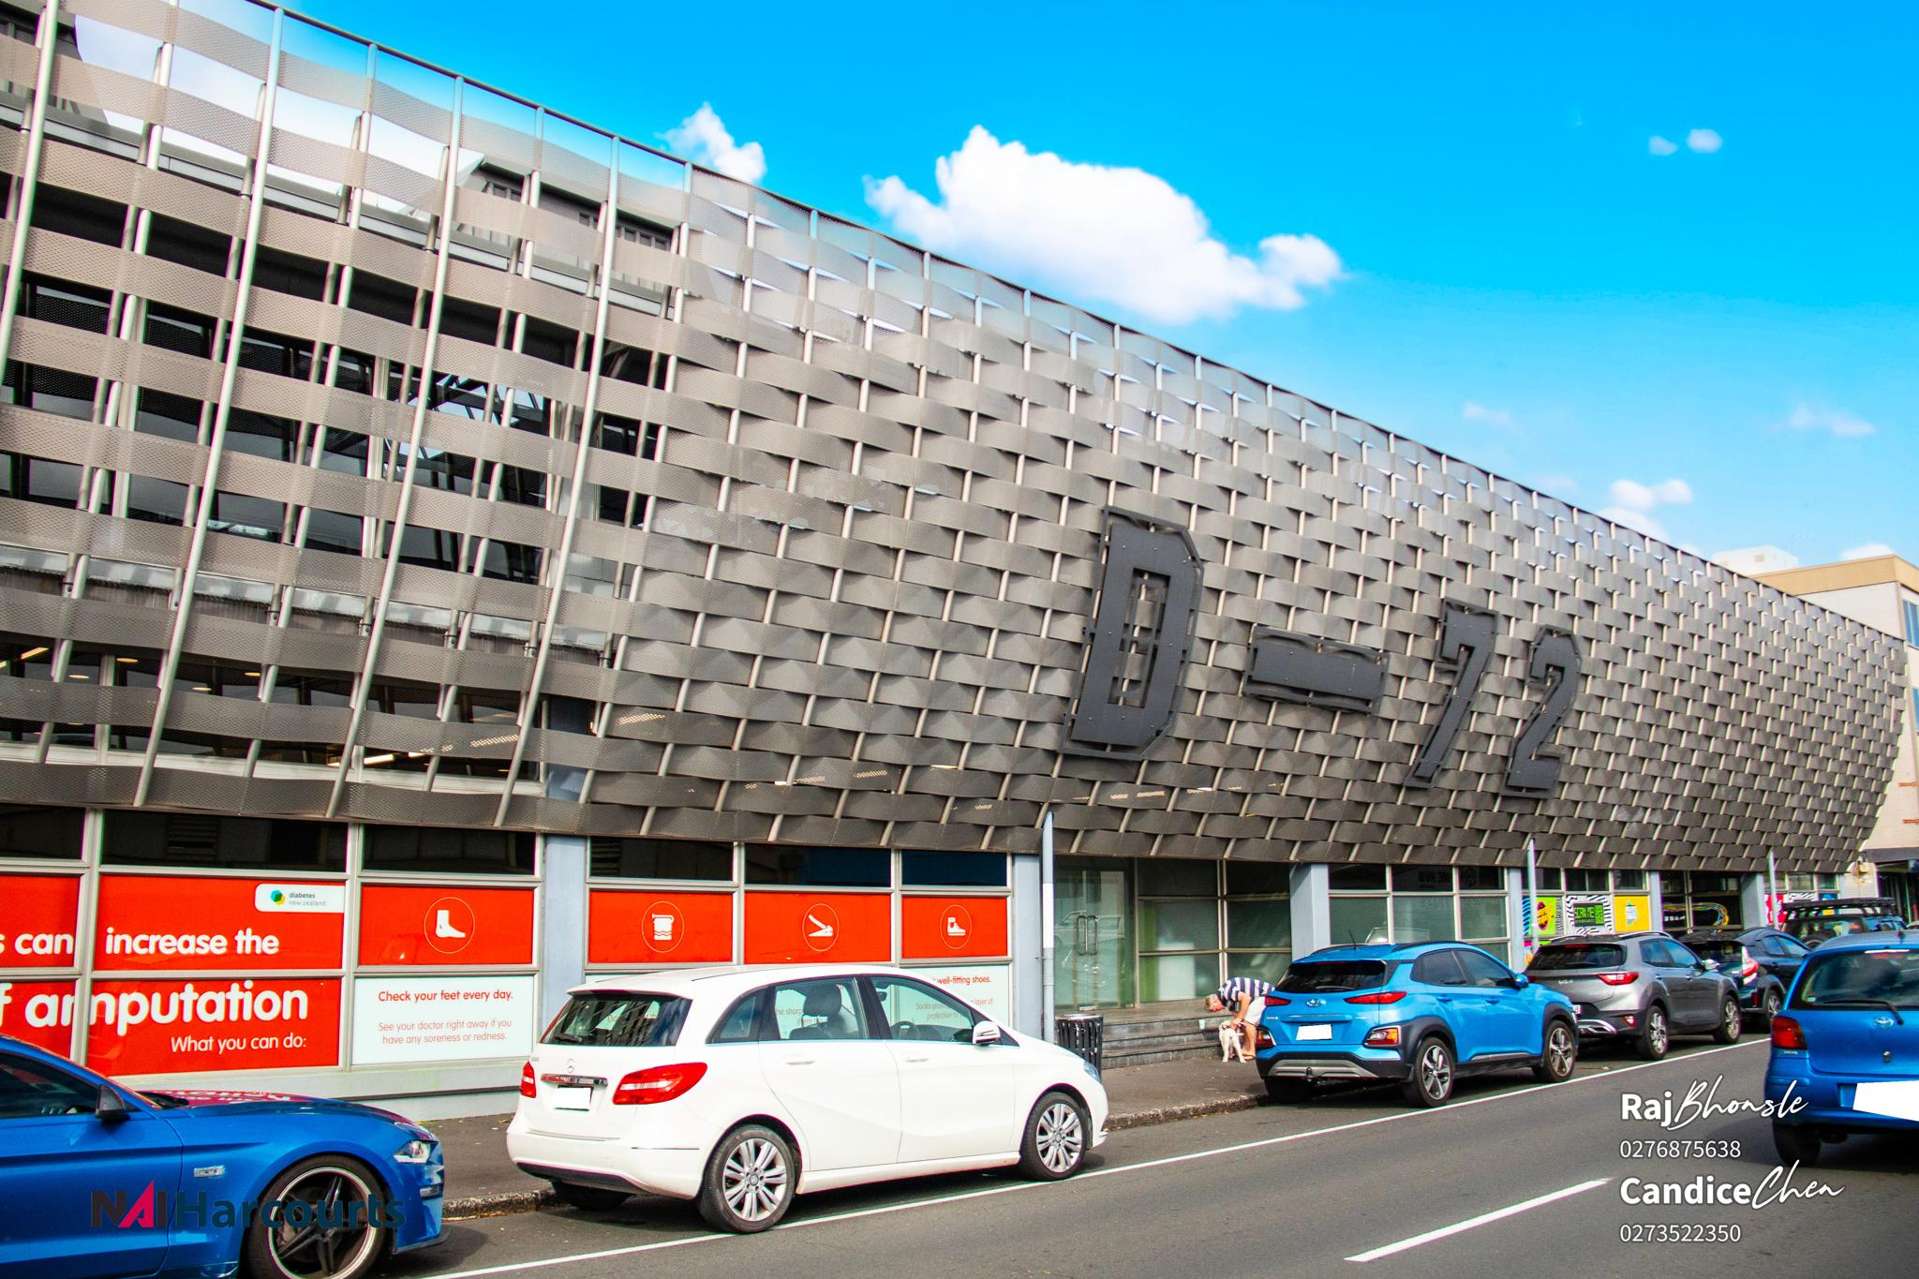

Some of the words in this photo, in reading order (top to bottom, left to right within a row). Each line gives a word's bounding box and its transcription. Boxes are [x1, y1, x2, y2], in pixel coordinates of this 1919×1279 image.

[14, 933, 74, 955] can
[105, 926, 228, 955] increase
[234, 927, 280, 955] the
[378, 990, 411, 1002] Check
[414, 992, 438, 1004] your
[440, 990, 461, 1001] feet
[463, 991, 490, 1003] every
[493, 989, 514, 1003] day.
[25, 980, 308, 1037] amputation
[378, 1022, 394, 1032] See
[396, 1023, 416, 1033] your
[417, 1020, 445, 1031] doctor
[446, 1018, 465, 1032] right
[466, 1021, 489, 1031] away
[497, 1021, 513, 1030] you
[170, 1034, 215, 1053] What
[218, 1037, 247, 1055] you
[250, 1036, 279, 1050] can
[282, 1033, 308, 1049] do:
[382, 1034, 404, 1045] have
[405, 1036, 422, 1046] any
[423, 1033, 461, 1043] soreness
[462, 1033, 472, 1041] or
